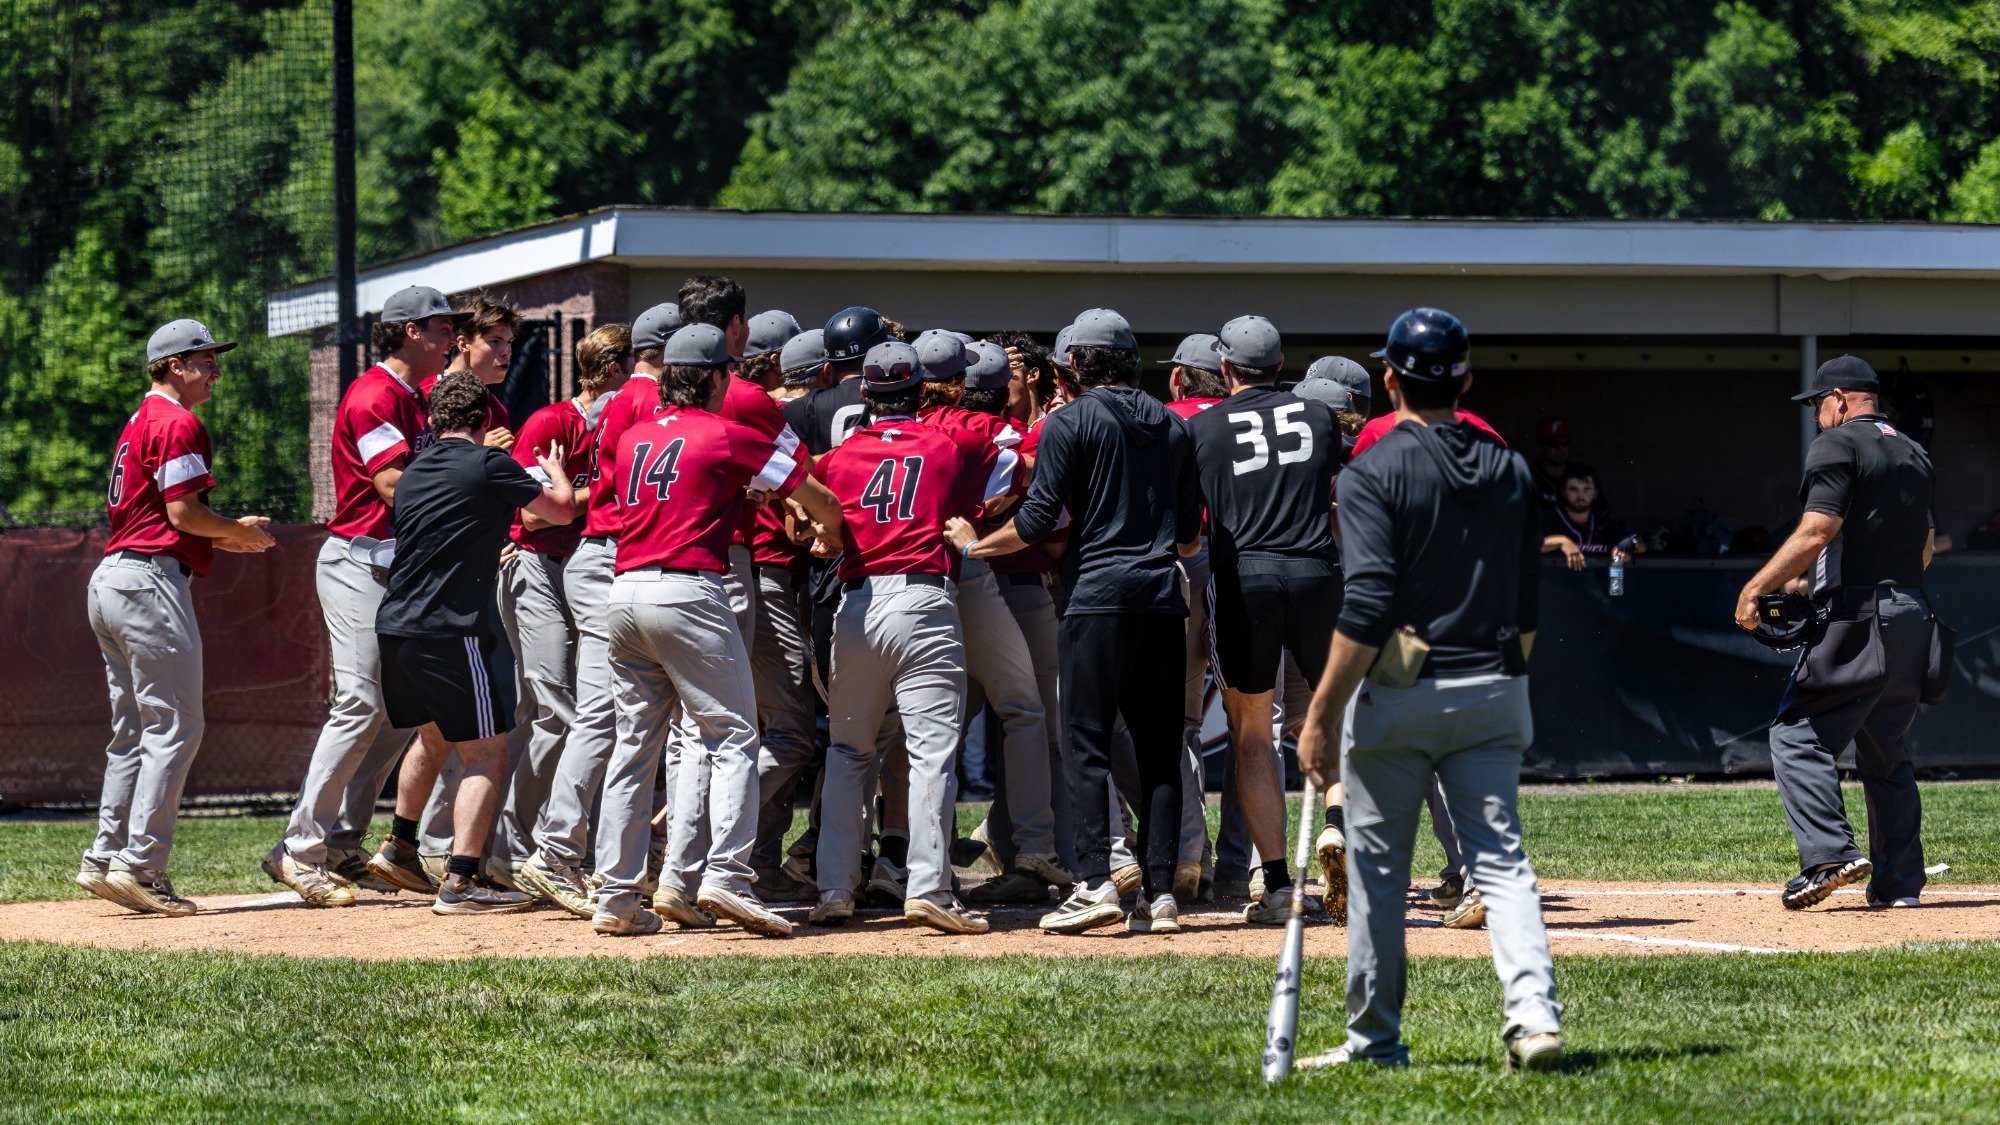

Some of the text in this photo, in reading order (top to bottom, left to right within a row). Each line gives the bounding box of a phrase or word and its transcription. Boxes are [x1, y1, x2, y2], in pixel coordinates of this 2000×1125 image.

[627, 438, 685, 506] 14
[1228, 402, 1313, 476] 35
[861, 456, 924, 523] 41
